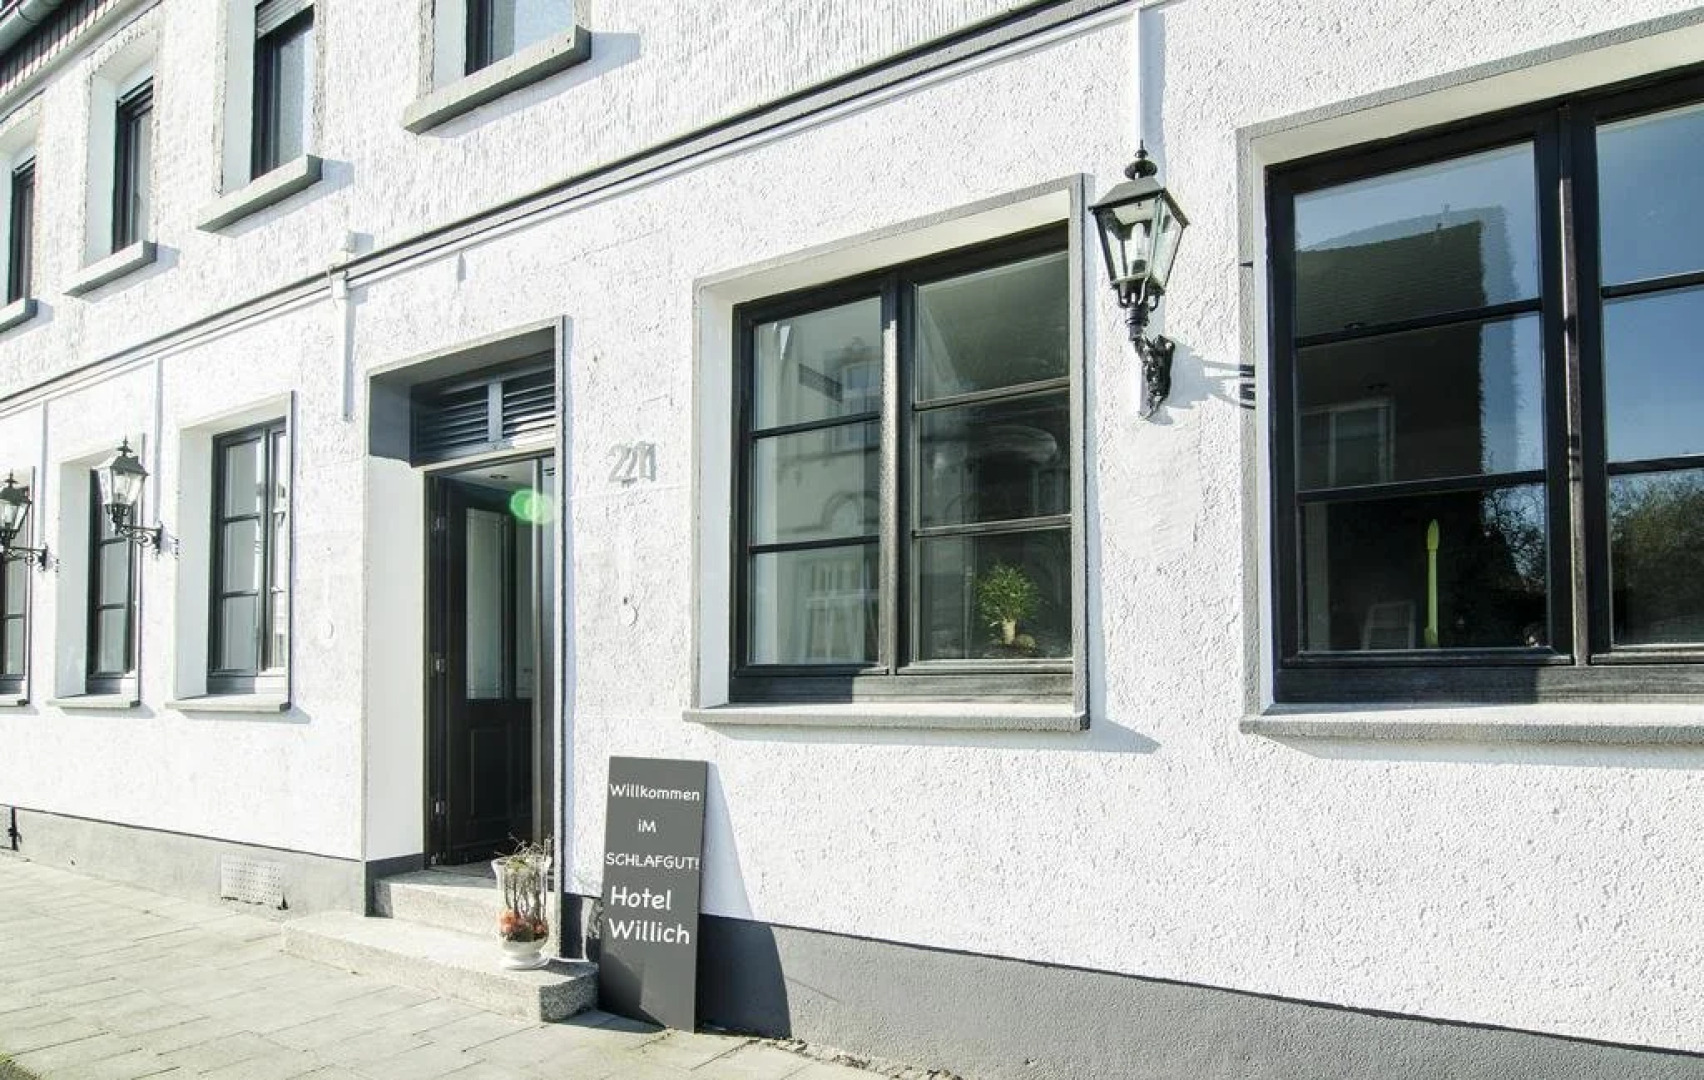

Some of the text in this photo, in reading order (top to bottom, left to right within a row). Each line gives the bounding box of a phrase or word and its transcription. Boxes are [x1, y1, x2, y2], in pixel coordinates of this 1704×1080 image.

[609, 783, 700, 801] Willkommen
[605, 852, 700, 870] SCHLAFGUT!
[610, 885, 672, 911] Hotel
[608, 918, 690, 945] Willich
